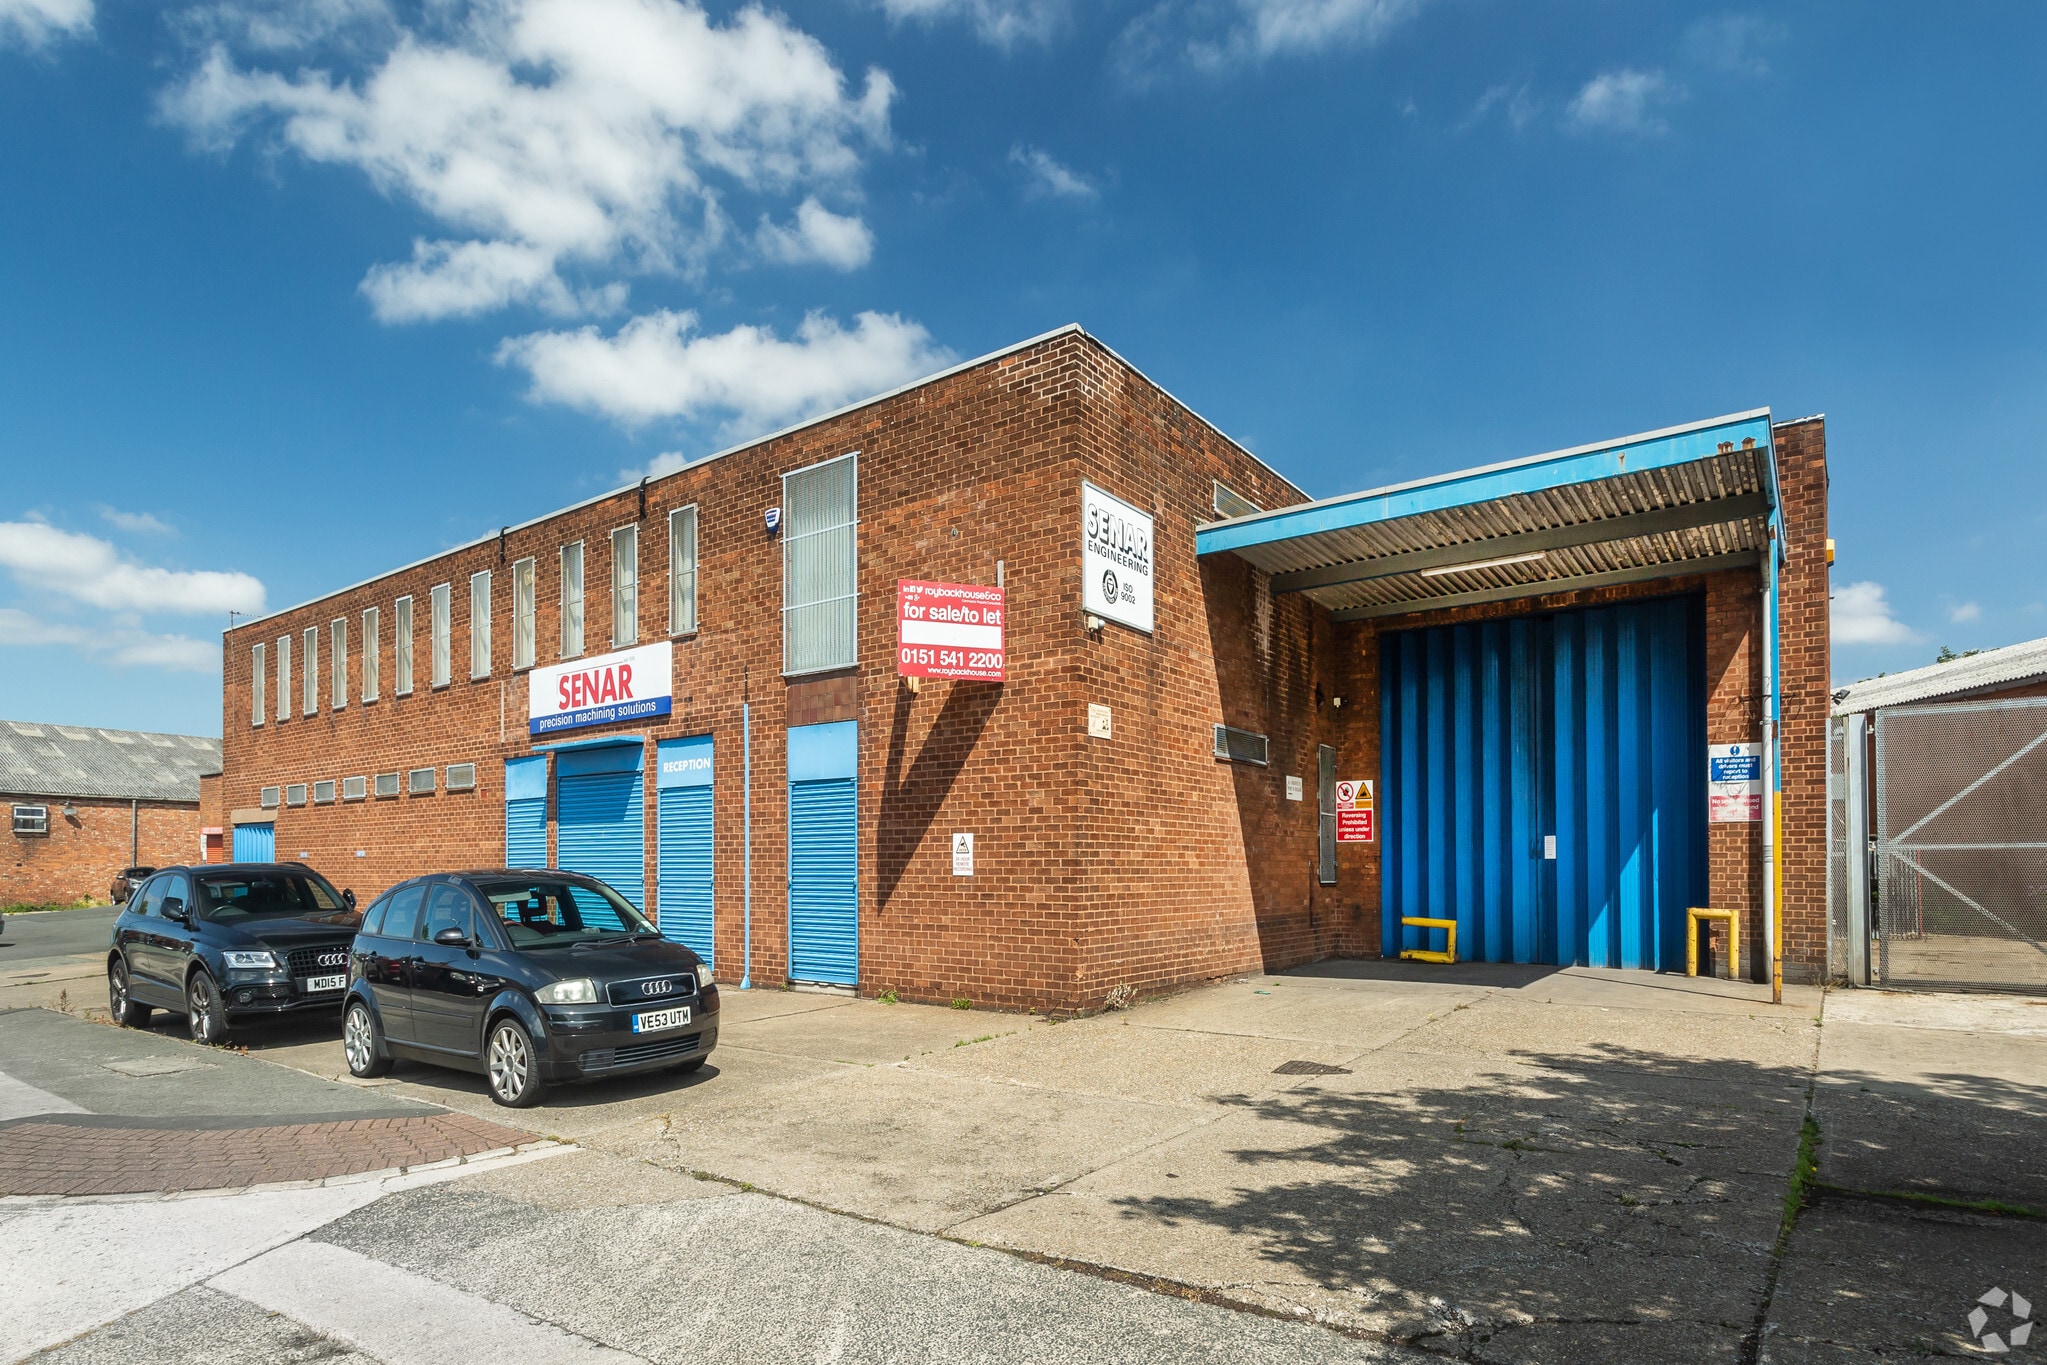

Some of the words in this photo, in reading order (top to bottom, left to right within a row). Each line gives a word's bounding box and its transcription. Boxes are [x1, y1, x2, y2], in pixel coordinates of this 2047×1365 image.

[1087, 503, 1149, 564] SENAR
[1088, 540, 1148, 576] ENGINEERING
[925, 587, 1002, 601] roybackhouse&co
[1120, 591, 1136, 604] 9002
[1123, 582, 1133, 594] ISO
[903, 602, 926, 619] for
[929, 605, 979, 623] sale/to
[983, 608, 1001, 624] let
[901, 648, 935, 665] 0151
[939, 650, 963, 667] 541
[968, 652, 1002, 669] 2200
[928, 667, 1002, 677] www.roybackhouse.com
[558, 664, 634, 710] SENAR
[539, 715, 573, 732] precision
[575, 705, 616, 723] machining
[618, 701, 657, 718] solutions
[663, 757, 711, 773] RECEPTION
[314, 978, 337, 989] MD15
[640, 1013, 668, 1029] VE53
[670, 1009, 689, 1024] UTM
